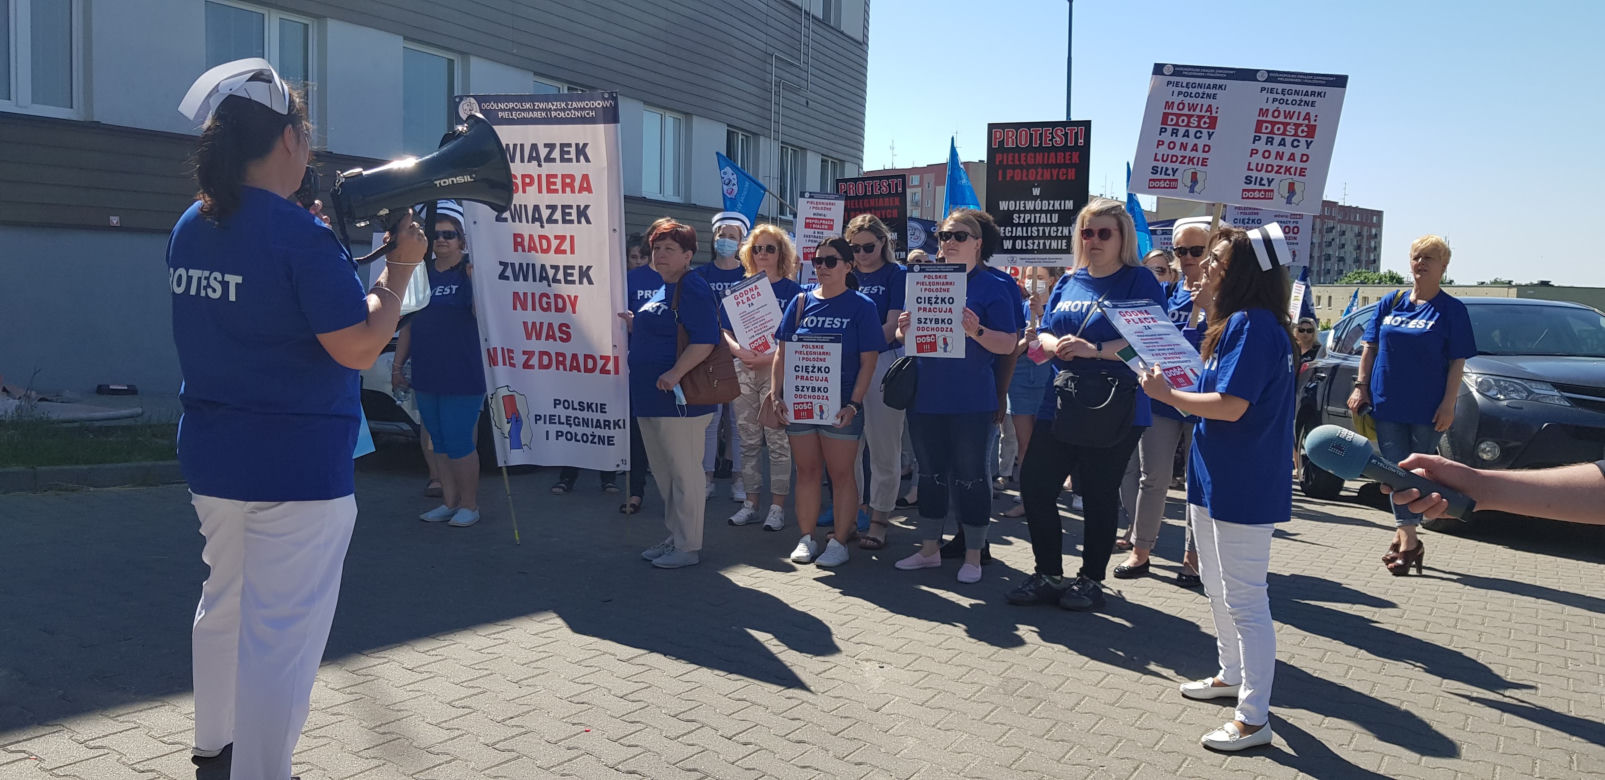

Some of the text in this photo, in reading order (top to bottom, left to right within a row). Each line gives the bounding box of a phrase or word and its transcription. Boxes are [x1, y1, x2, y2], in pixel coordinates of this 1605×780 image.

[1166, 80, 1227, 91] PIELĘGNIARKI
[1260, 86, 1326, 98] PIELĘGNIARKI
[1177, 90, 1218, 100] POŁOŻNE
[482, 100, 614, 110] OGÓLNOPOLSKI ZWIĄZEK ZAWODOWY
[1164, 100, 1219, 115] MÓWIĄ:
[1272, 97, 1316, 107] POŁOŻNE
[498, 111, 546, 119] PIELĘGNIAREK
[1167, 115, 1210, 128] DOŚĆ
[1258, 107, 1318, 123] MÓWIĄ:
[1159, 127, 1214, 140] PRACY
[1262, 122, 1308, 136] DOŚĆ
[992, 126, 1085, 148] PROTEST!
[1252, 135, 1313, 149] PRACY
[1156, 140, 1211, 153] PONAD
[503, 142, 591, 168] WIĄZEK
[996, 152, 1080, 166] PIELĘGNIAREK
[1154, 153, 1209, 166] LUDZKIE
[1250, 148, 1310, 163] PONAD
[998, 168, 1076, 181] I POŁOŻNYCH
[1150, 166, 1178, 176] SIŁY
[1247, 162, 1307, 177] LUDZKIE
[511, 173, 593, 194] SPIERA
[838, 179, 902, 196] PROTEST!
[1244, 175, 1274, 187] SIŁY
[1032, 187, 1040, 196] W
[999, 198, 1073, 211] WOJEWÓDZKIM
[1013, 214, 1058, 223] SZPITALU
[1233, 217, 1262, 225] CIĘŻKO
[513, 233, 575, 255] RADZI
[1003, 239, 1067, 250] W OLSZTYNIE
[498, 261, 594, 287] ZWIĄZEK
[734, 285, 759, 301] GODNA
[736, 291, 761, 307] PŁACA
[512, 292, 578, 314] NIGDY
[916, 295, 954, 306] CIĘŻKO
[523, 321, 572, 343] WAS
[487, 347, 620, 375] NIE ZDRADZI
[794, 364, 830, 374] CIĘŻKO
[795, 375, 828, 383] PRACUJĄ
[795, 385, 828, 393] SZYBKO
[553, 398, 607, 414] POLSKIE
[534, 414, 626, 430] PIELĘGNIARKI
[546, 430, 615, 446] I POŁOŻNE
